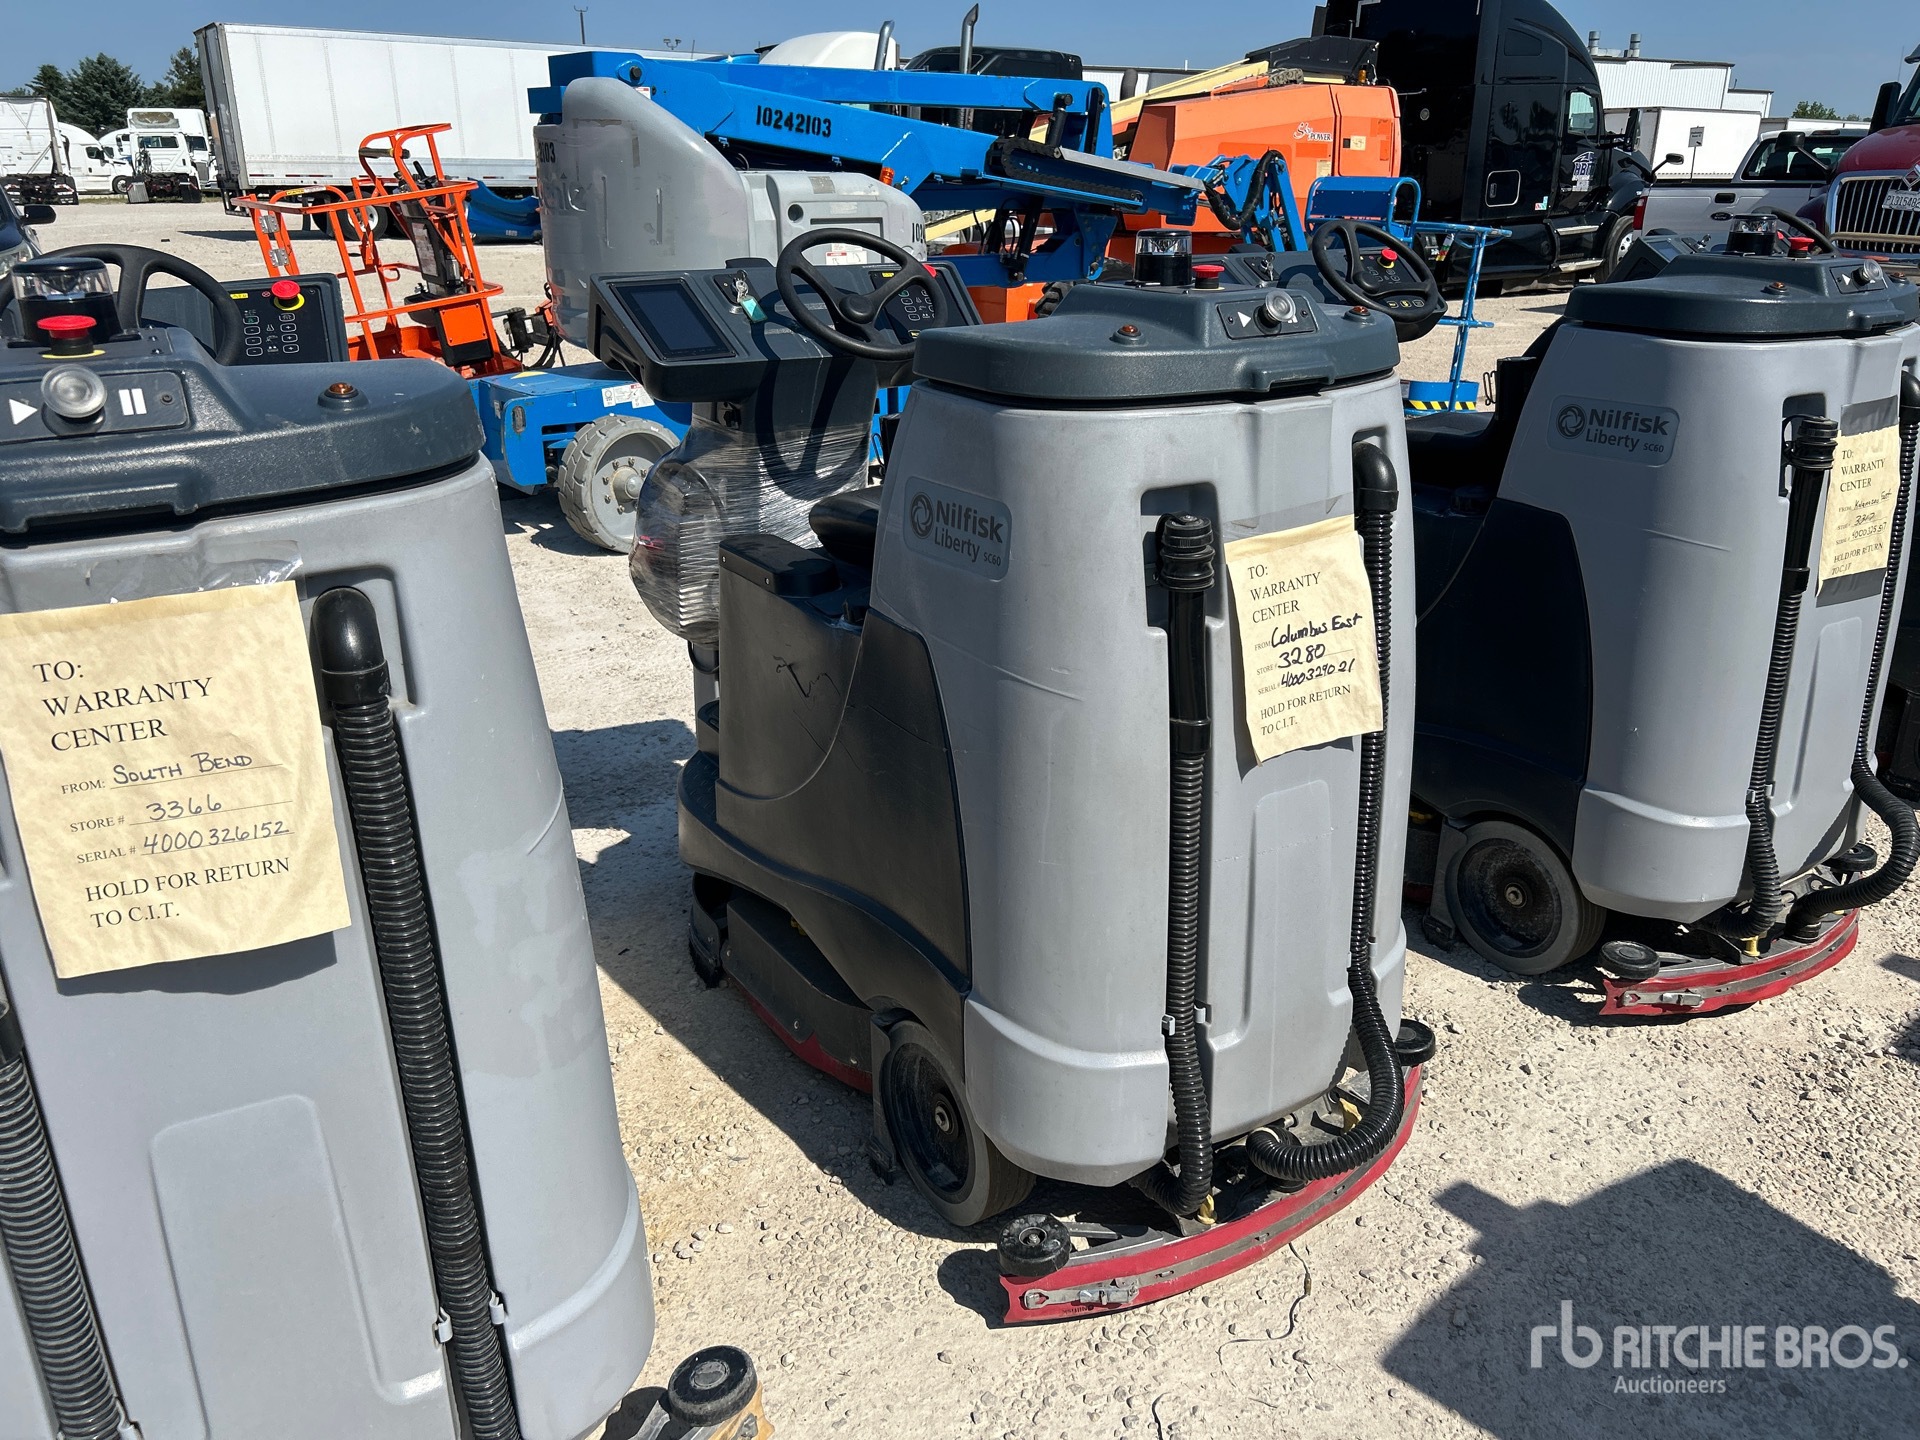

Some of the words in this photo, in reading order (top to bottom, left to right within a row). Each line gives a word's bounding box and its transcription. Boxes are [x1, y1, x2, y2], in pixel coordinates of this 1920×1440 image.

[756, 105, 832, 138] 10242103
[1588, 408, 1670, 436] Nilfisk
[1585, 429, 1640, 452] Liberty
[1643, 442, 1664, 453] SC60
[1841, 458, 1885, 476] WARRANTY
[1840, 478, 1872, 493] CENTER
[936, 500, 1003, 543] Nilfisk
[934, 526, 980, 563] Liberty
[983, 552, 1001, 567] SC60
[1247, 564, 1268, 580] TO:
[1250, 571, 1321, 601] WARRANTY
[1252, 599, 1301, 624] CENTER
[1271, 620, 1328, 648] Columbus
[1331, 612, 1363, 631] East
[32, 660, 84, 683] TO:
[1256, 665, 1274, 676] STORE
[1278, 643, 1326, 669] 3280
[42, 677, 213, 717] WARRANTY
[1257, 684, 1277, 696] SERIAL
[1260, 702, 1285, 720] HOLD
[1287, 696, 1307, 710] FOR
[1309, 684, 1351, 704] RETURN
[51, 718, 169, 751] CENTER
[1261, 722, 1275, 736] TO
[61, 779, 106, 795] FROM:
[70, 817, 115, 833] STORE
[146, 794, 222, 821] 3366
[77, 848, 126, 864] SERIAL
[85, 878, 149, 902] HOLD
[155, 871, 200, 892] FOR
[204, 857, 290, 885] RETURN
[90, 911, 122, 928] TO
[128, 902, 180, 922] C.I.T.
